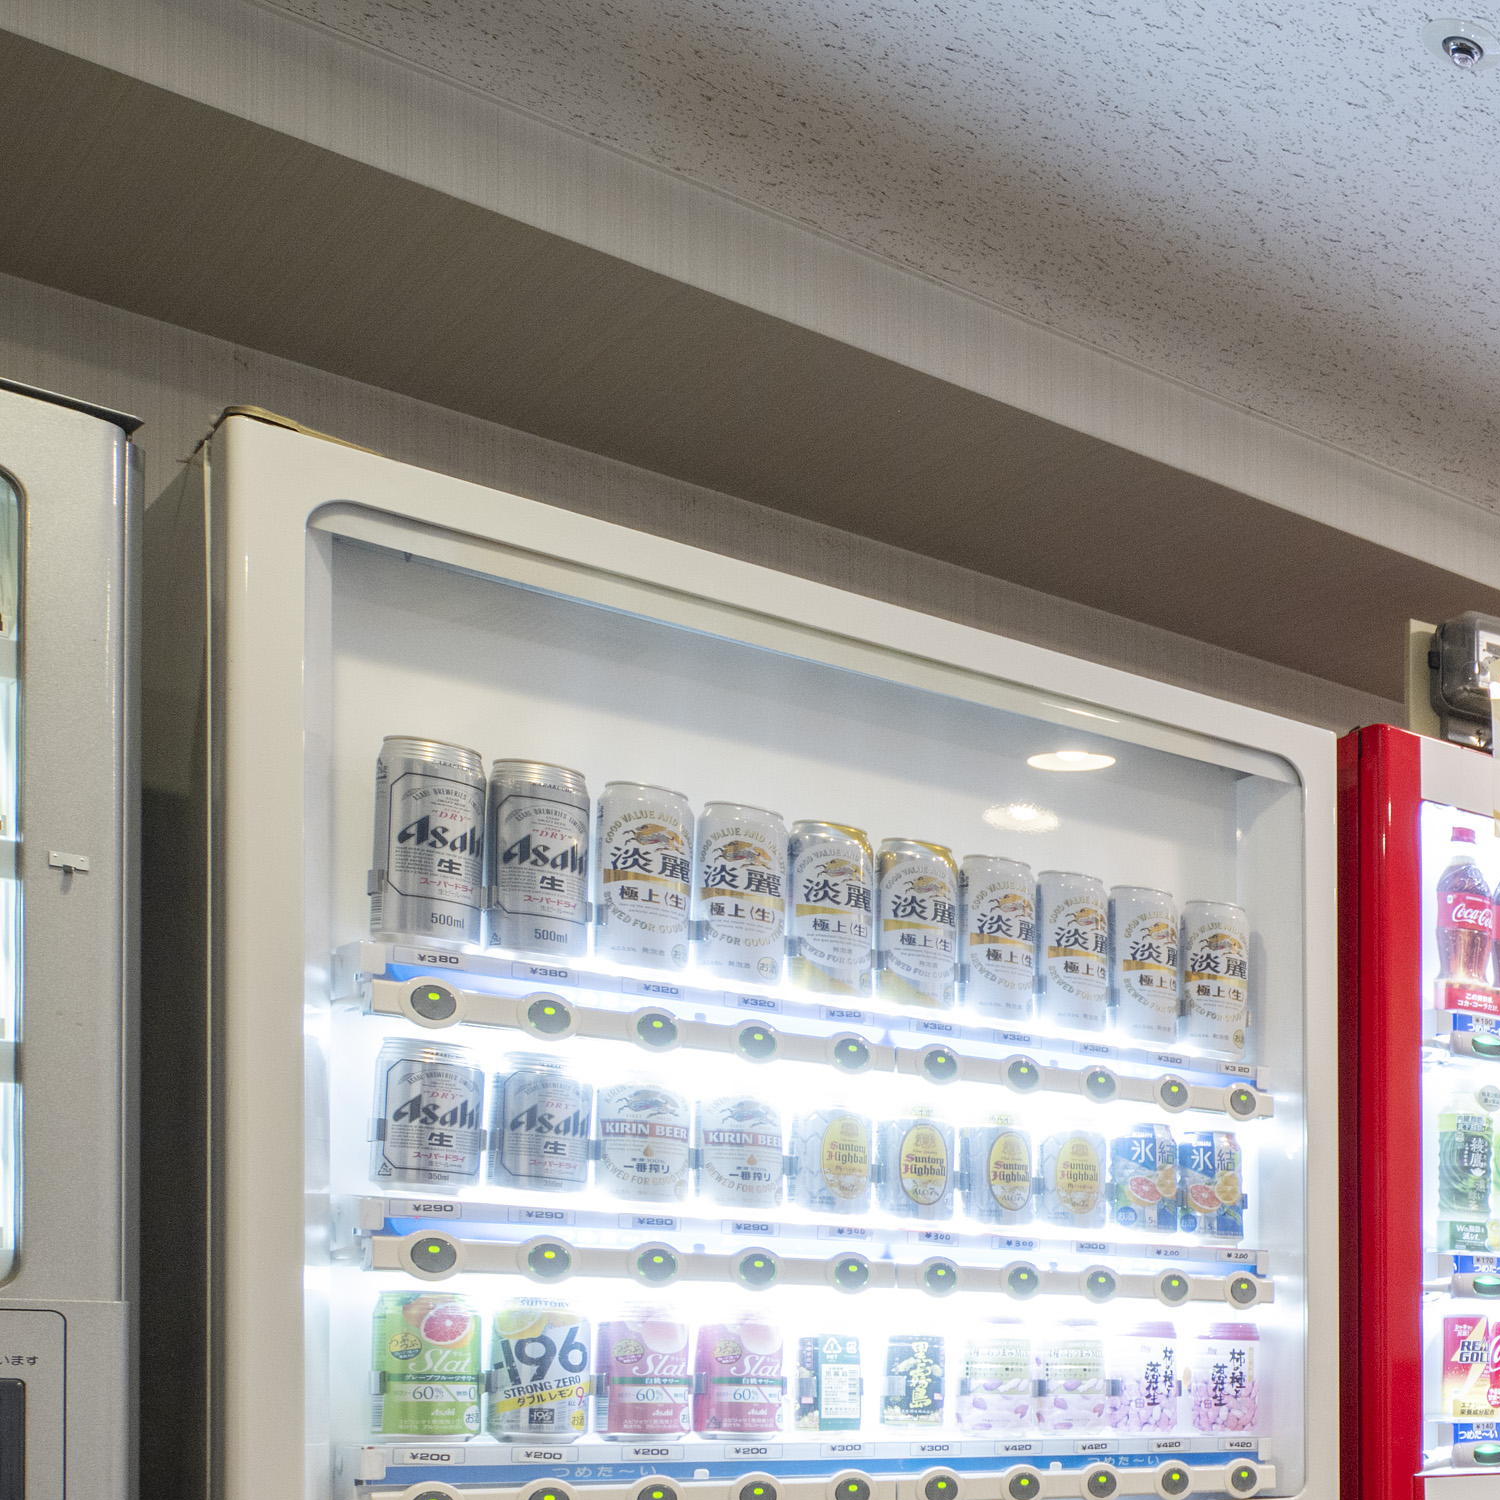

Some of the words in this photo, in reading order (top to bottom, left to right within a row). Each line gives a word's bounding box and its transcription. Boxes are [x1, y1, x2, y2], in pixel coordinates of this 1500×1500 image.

[437, 858, 462, 876] 生
[610, 846, 690, 884] 淡麗
[419, 877, 474, 894] スーパードライ
[703, 861, 783, 898] 淡麗
[803, 878, 872, 913] 淡麗
[431, 912, 464, 929] 500ml
[534, 927, 568, 944] 500ml
[417, 953, 459, 965] ¥380
[529, 966, 568, 979] ¥380
[643, 984, 679, 995] ¥320
[742, 999, 775, 1009] ¥320
[605, 1121, 652, 1137] KIRIN
[655, 1124, 688, 1139] BEER
[709, 1131, 747, 1145] KIRIN
[829, 1140, 867, 1155] Suntory
[1470, 1136, 1485, 1167] 綾鷹
[826, 1150, 868, 1165] Highball
[905, 1154, 945, 1167] Suntory
[1190, 1142, 1236, 1170] 氷結
[623, 1162, 672, 1175] 一番搾り
[729, 1169, 772, 1182] 一番搾り
[903, 1164, 946, 1177] Highball
[427, 1172, 450, 1181] 350ml
[412, 1203, 454, 1214] ¥290
[526, 1210, 564, 1220] ¥290
[837, 1227, 866, 1236] ¥300
[1156, 1249, 1180, 1257] ¥200
[408, 1349, 473, 1373] Slat
[493, 1326, 588, 1386] -196
[632, 1354, 684, 1376] Slat
[733, 1354, 783, 1376] Slat
[504, 1382, 553, 1399] STRONG
[554, 1375, 581, 1389] ZERO
[517, 1393, 546, 1407] ダブル
[549, 1388, 573, 1400] レモン
[1460, 1408, 1495, 1416] 栄養成分配合
[1003, 1442, 1032, 1452] ¥420
[1081, 1442, 1108, 1451] ¥420
[552, 1465, 657, 1478] つめた〜い
